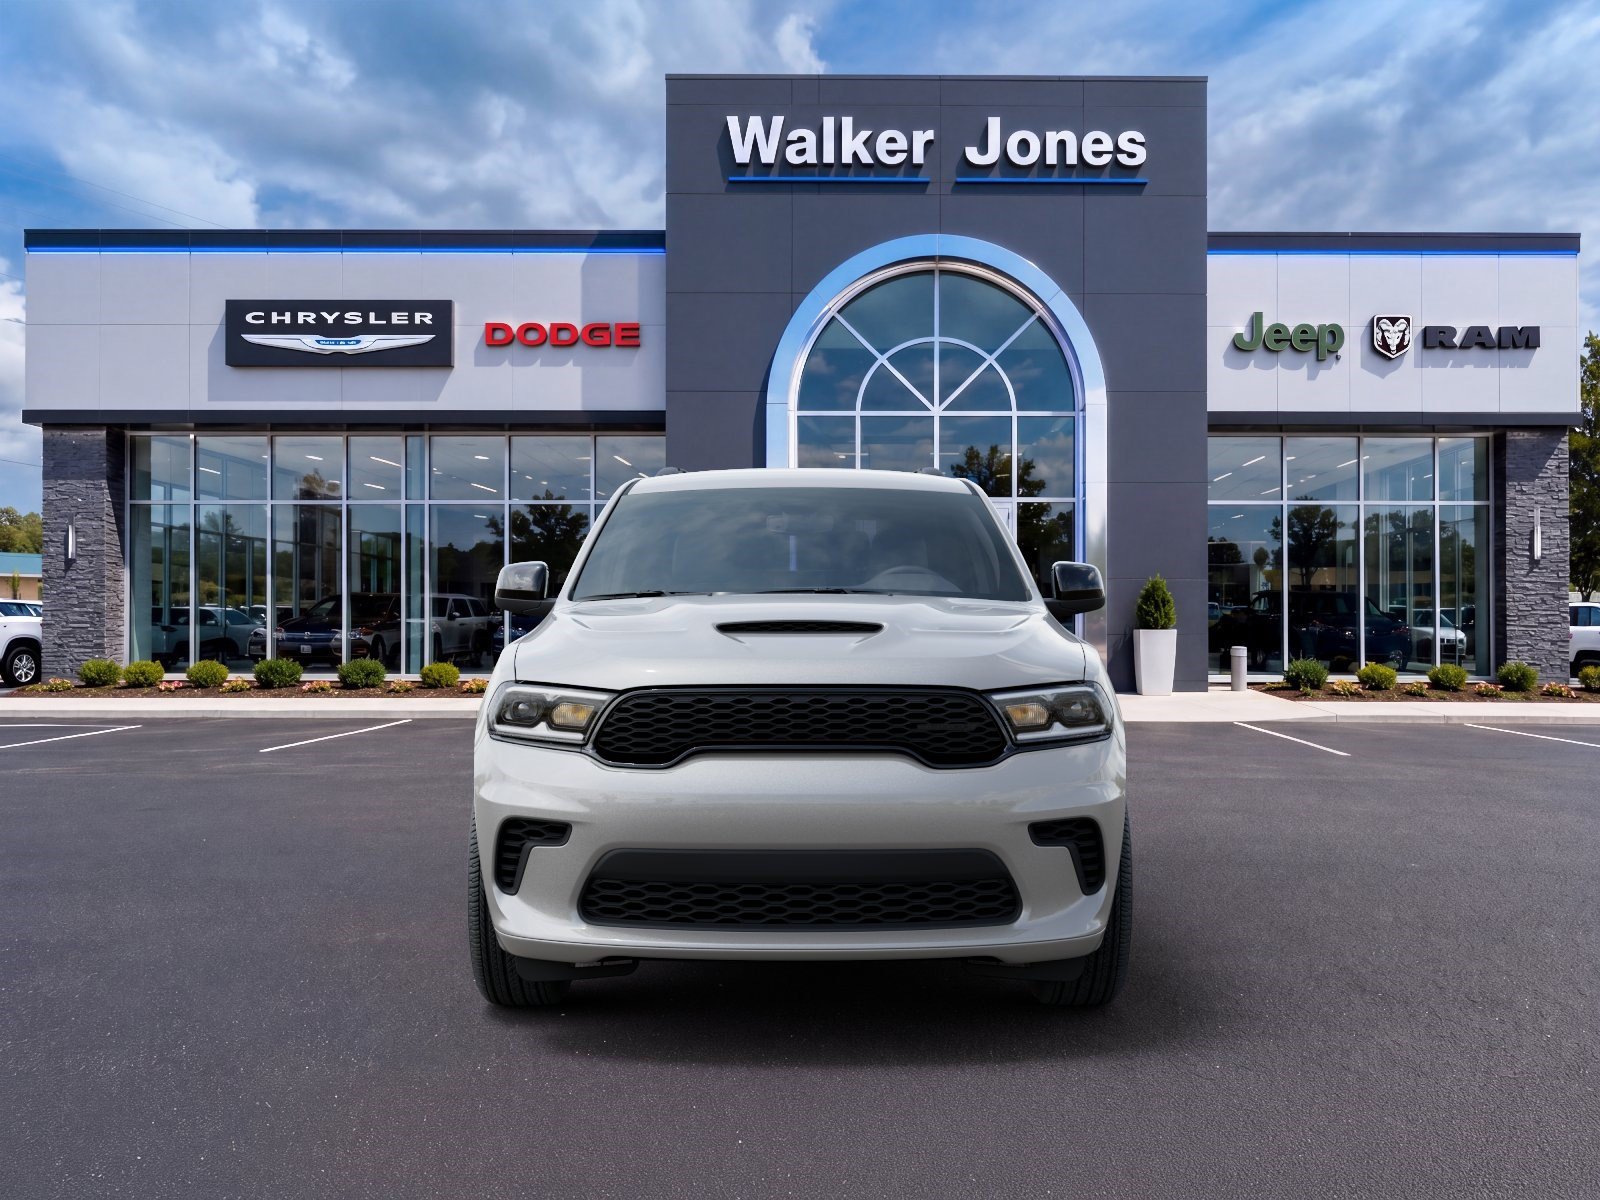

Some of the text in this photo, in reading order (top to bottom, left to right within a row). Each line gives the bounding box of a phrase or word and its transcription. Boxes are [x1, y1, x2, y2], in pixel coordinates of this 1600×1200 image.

[726, 115, 1147, 167] Walker Jones
[245, 311, 434, 325] CHRYSLER
[485, 322, 640, 348] DODGE
[1234, 311, 1345, 362] Jeep
[1424, 325, 1541, 348] RAM
